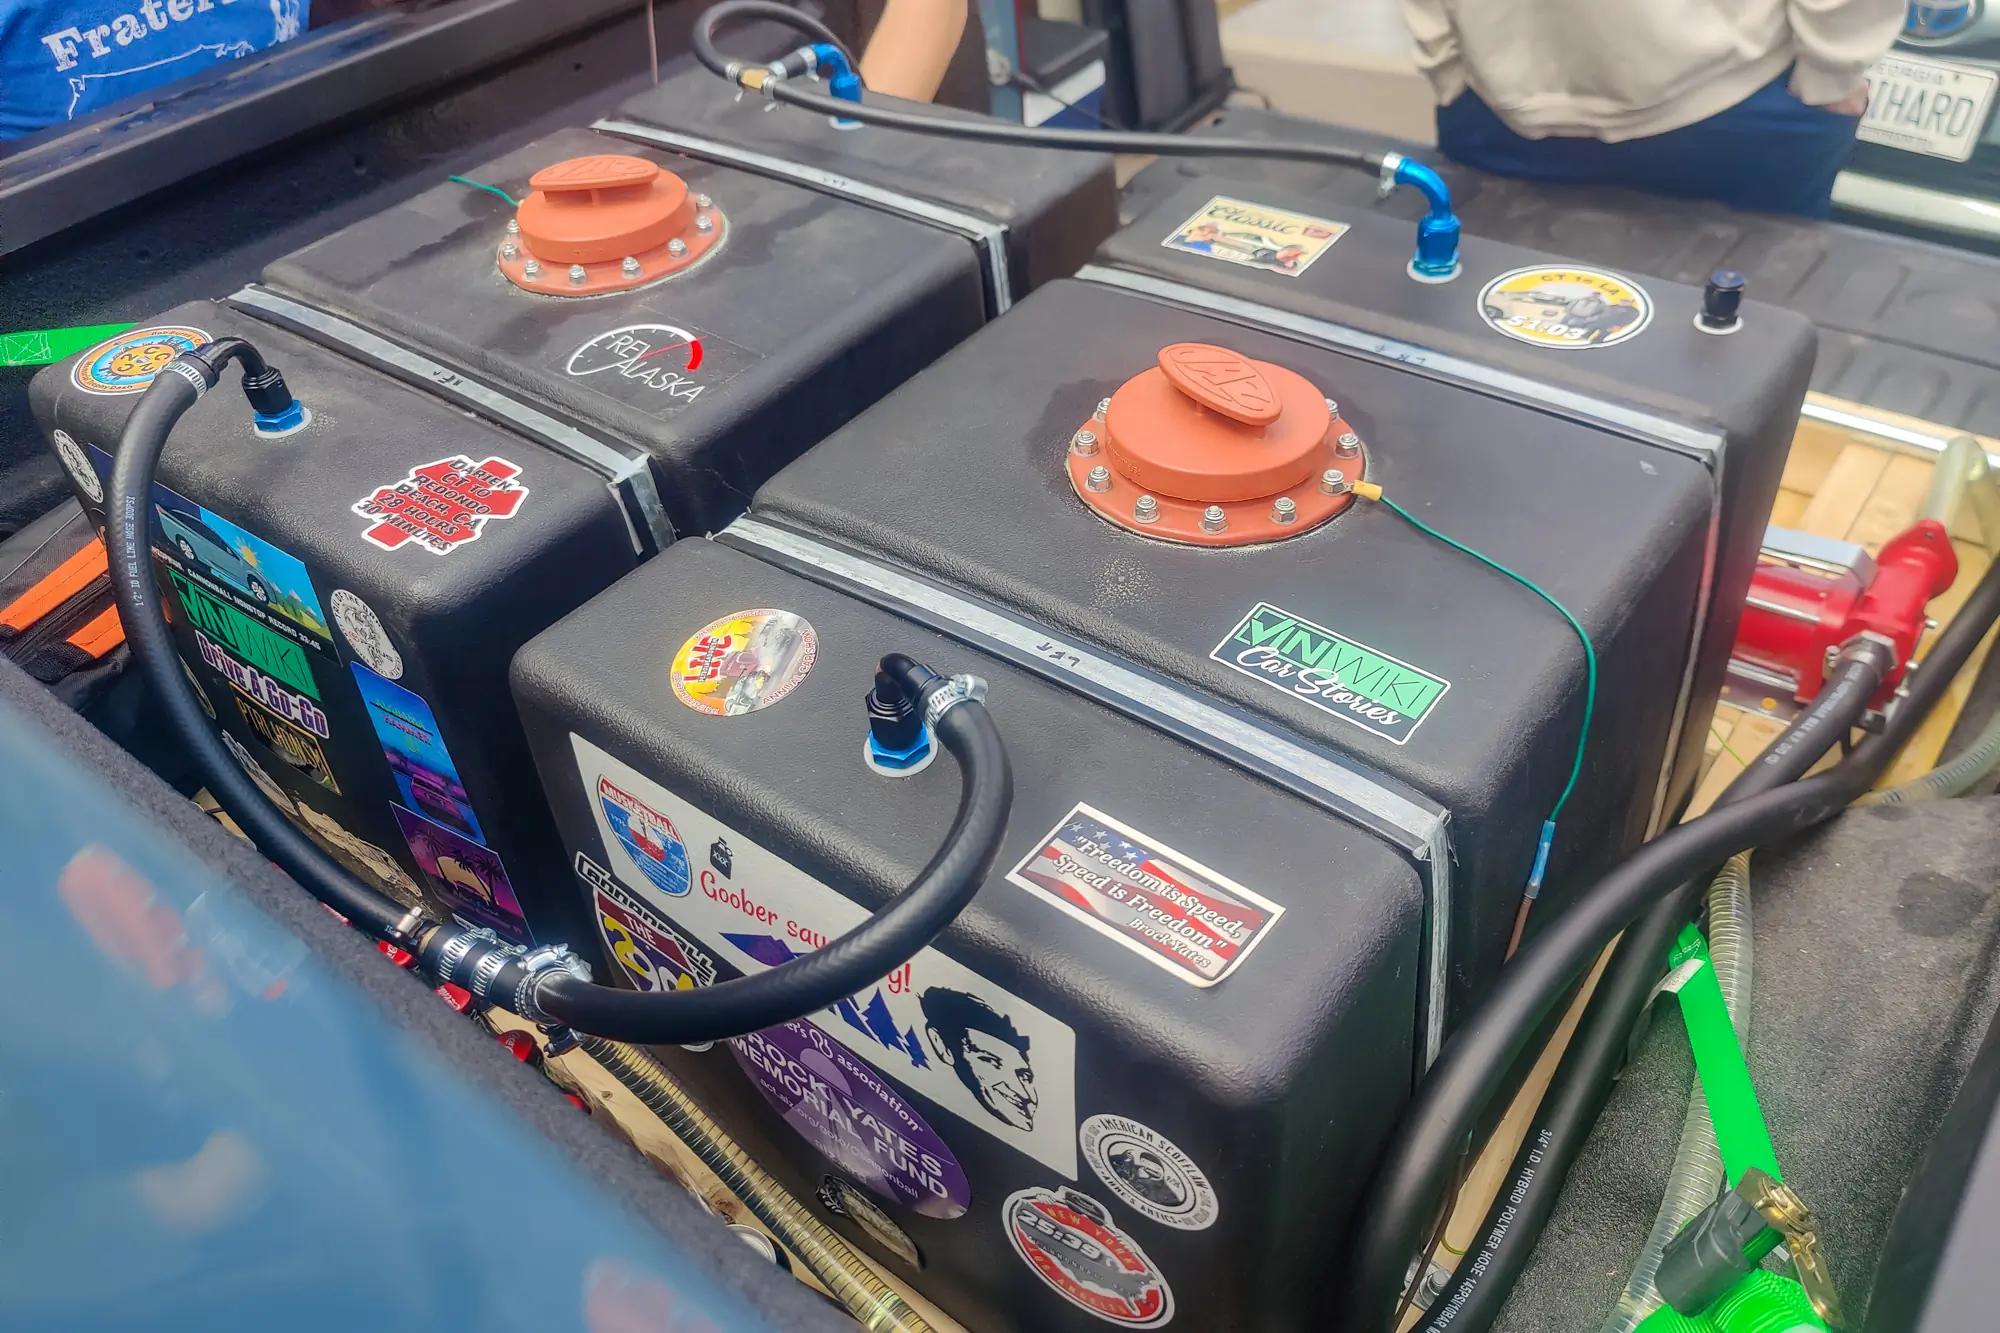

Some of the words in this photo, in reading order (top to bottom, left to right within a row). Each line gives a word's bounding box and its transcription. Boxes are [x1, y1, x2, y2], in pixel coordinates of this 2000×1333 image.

[614, 358, 706, 403] ALASKA
[411, 474, 491, 515] REDONDO
[441, 473, 470, 487] CT
[469, 485, 492, 498] TO
[449, 459, 511, 493] DARIEN,
[126, 495, 136, 519] 300PSI
[126, 519, 135, 540] HOSE
[357, 500, 382, 515] 30
[381, 513, 452, 551] MINUTES
[379, 493, 404, 508] 28
[404, 505, 459, 535] HOURS
[394, 484, 450, 516] BEACH,
[452, 511, 483, 530] CA
[126, 541, 136, 559] LINE
[128, 561, 138, 578] FUEL
[249, 667, 267, 702] A
[762, 673, 805, 705] ANNUAL
[798, 628, 817, 675] CARSHOW
[1236, 645, 1297, 678] Car
[1294, 667, 1401, 725] Stories
[602, 782, 681, 842] MUSKETBALL
[700, 870, 778, 926] Goober
[1052, 853, 1111, 897] Speed
[1108, 877, 1128, 900] is
[1075, 835, 1158, 892] "Freedom
[1160, 877, 1182, 902] is
[1180, 894, 1242, 938] Speed,
[624, 913, 656, 945] THE
[1128, 917, 1173, 950] Brock
[1170, 940, 1211, 969] Yates
[746, 1032, 831, 1100] ROCK
[843, 1096, 943, 1177] YATES
[874, 1135, 948, 1199] FUND
[1100, 1118, 1153, 1143] AMERICAN
[1158, 1140, 1208, 1189] SCOFFLAW
[1510, 1166, 1535, 1204] HYBRID
[1017, 1209, 1100, 1260] 25:39
[1046, 1208, 1081, 1225] NEW
[1095, 1228, 1136, 1266] YORK
[1485, 1205, 1517, 1250] POLYMER
[1470, 1250, 1493, 1277] HOSE
[1433, 1278, 1477, 1333] 145PSI/10BAR
